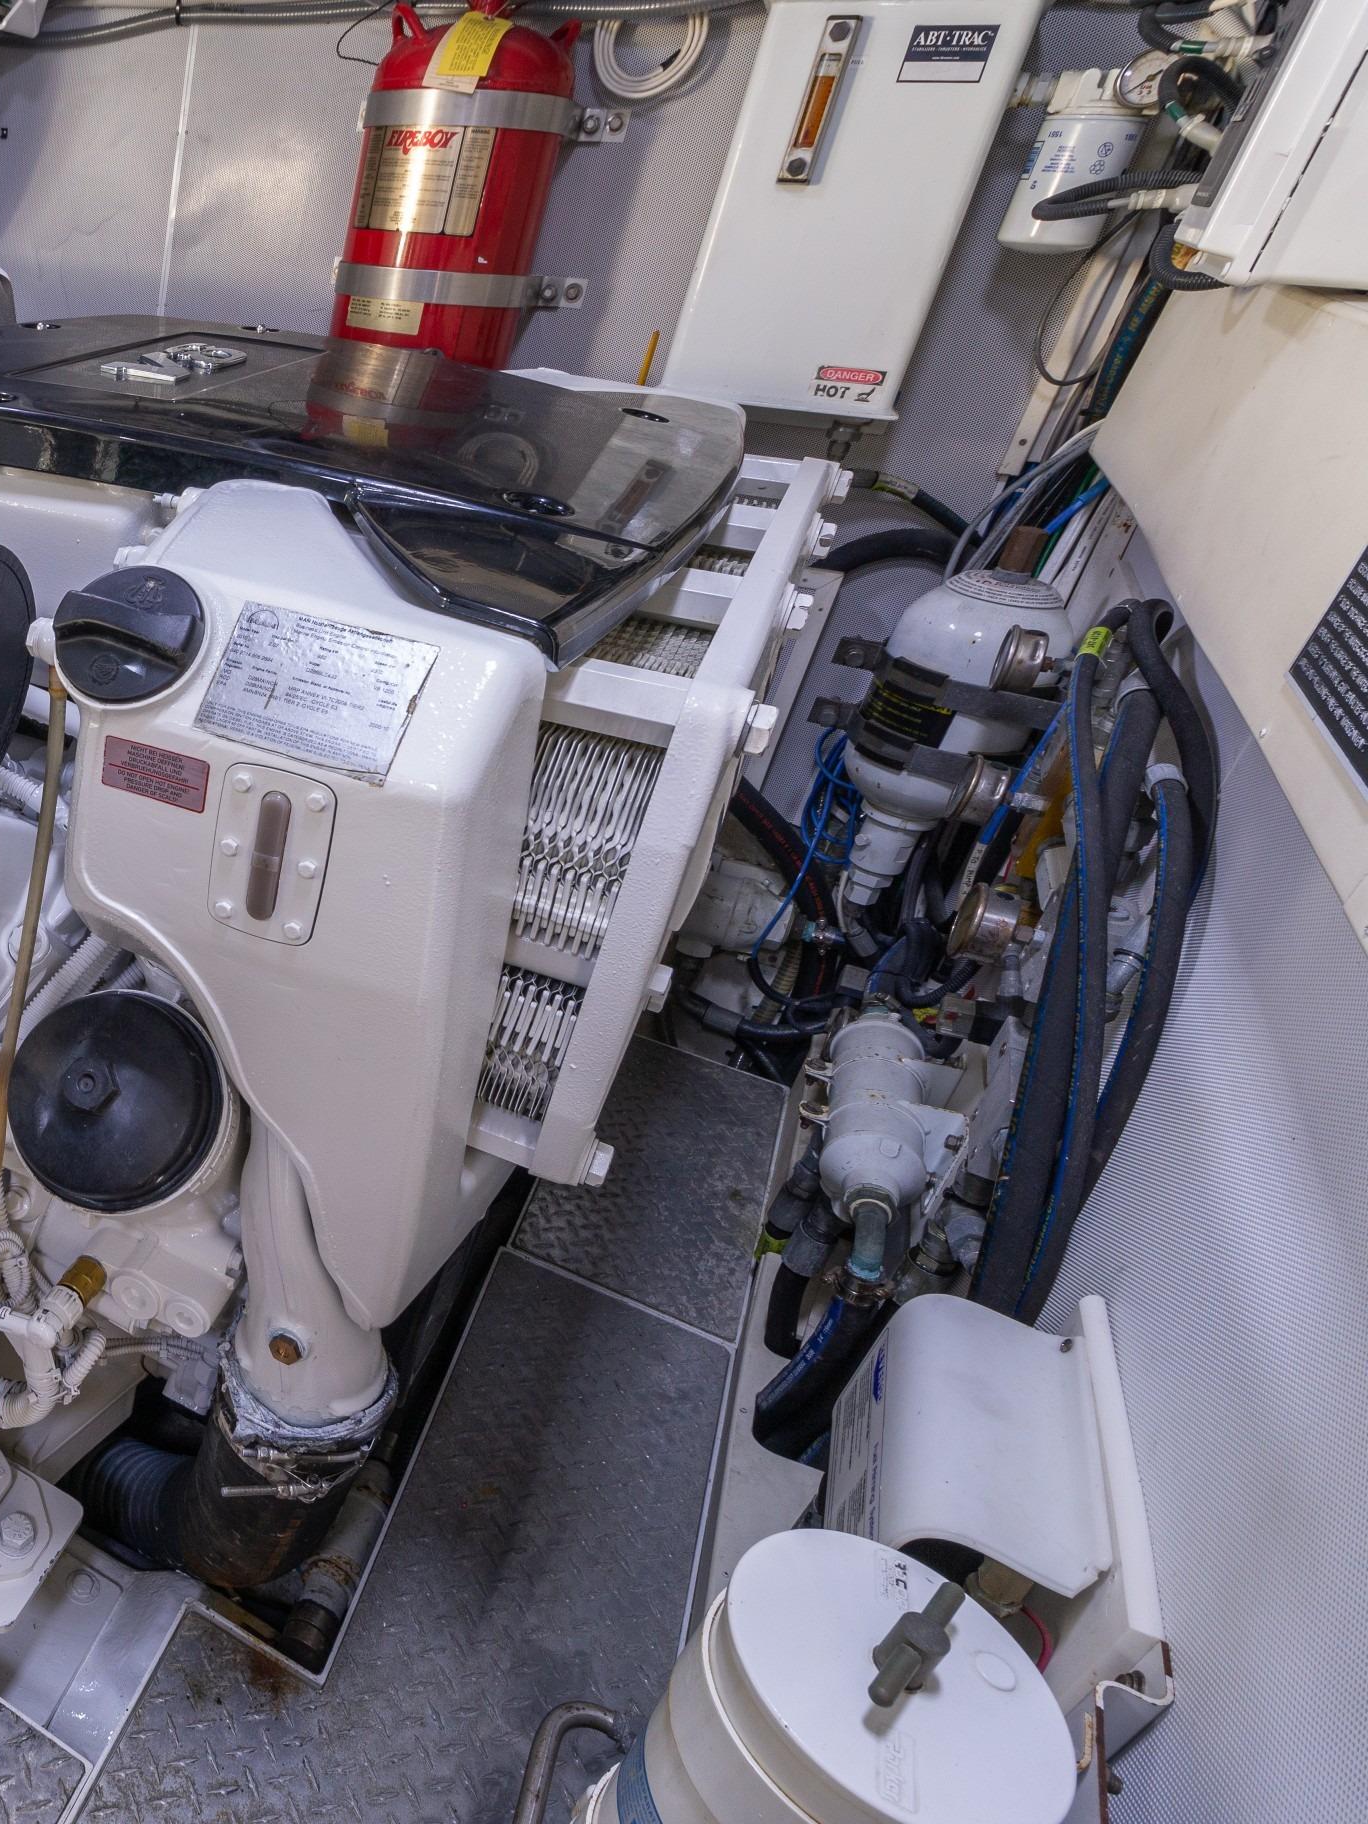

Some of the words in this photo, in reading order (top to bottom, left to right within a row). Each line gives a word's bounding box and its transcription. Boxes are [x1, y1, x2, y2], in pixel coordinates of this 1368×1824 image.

[385, 128, 459, 156] FIREBOY
[826, 369, 875, 382] DANGER
[813, 383, 851, 399] HOT
[127, 750, 157, 762] MASCHINE
[130, 745, 148, 754] NICHT
[128, 756, 169, 772] DRUCKABFALL
[169, 767, 183, 776] UND
[126, 771, 137, 779] NOT
[138, 774, 154, 784] OPEN
[154, 779, 167, 788] HOT
[123, 777, 153, 790] PRESSURE
[153, 785, 169, 794] DROP
[169, 790, 183, 799] AND
[125, 783, 150, 794] DANGER
